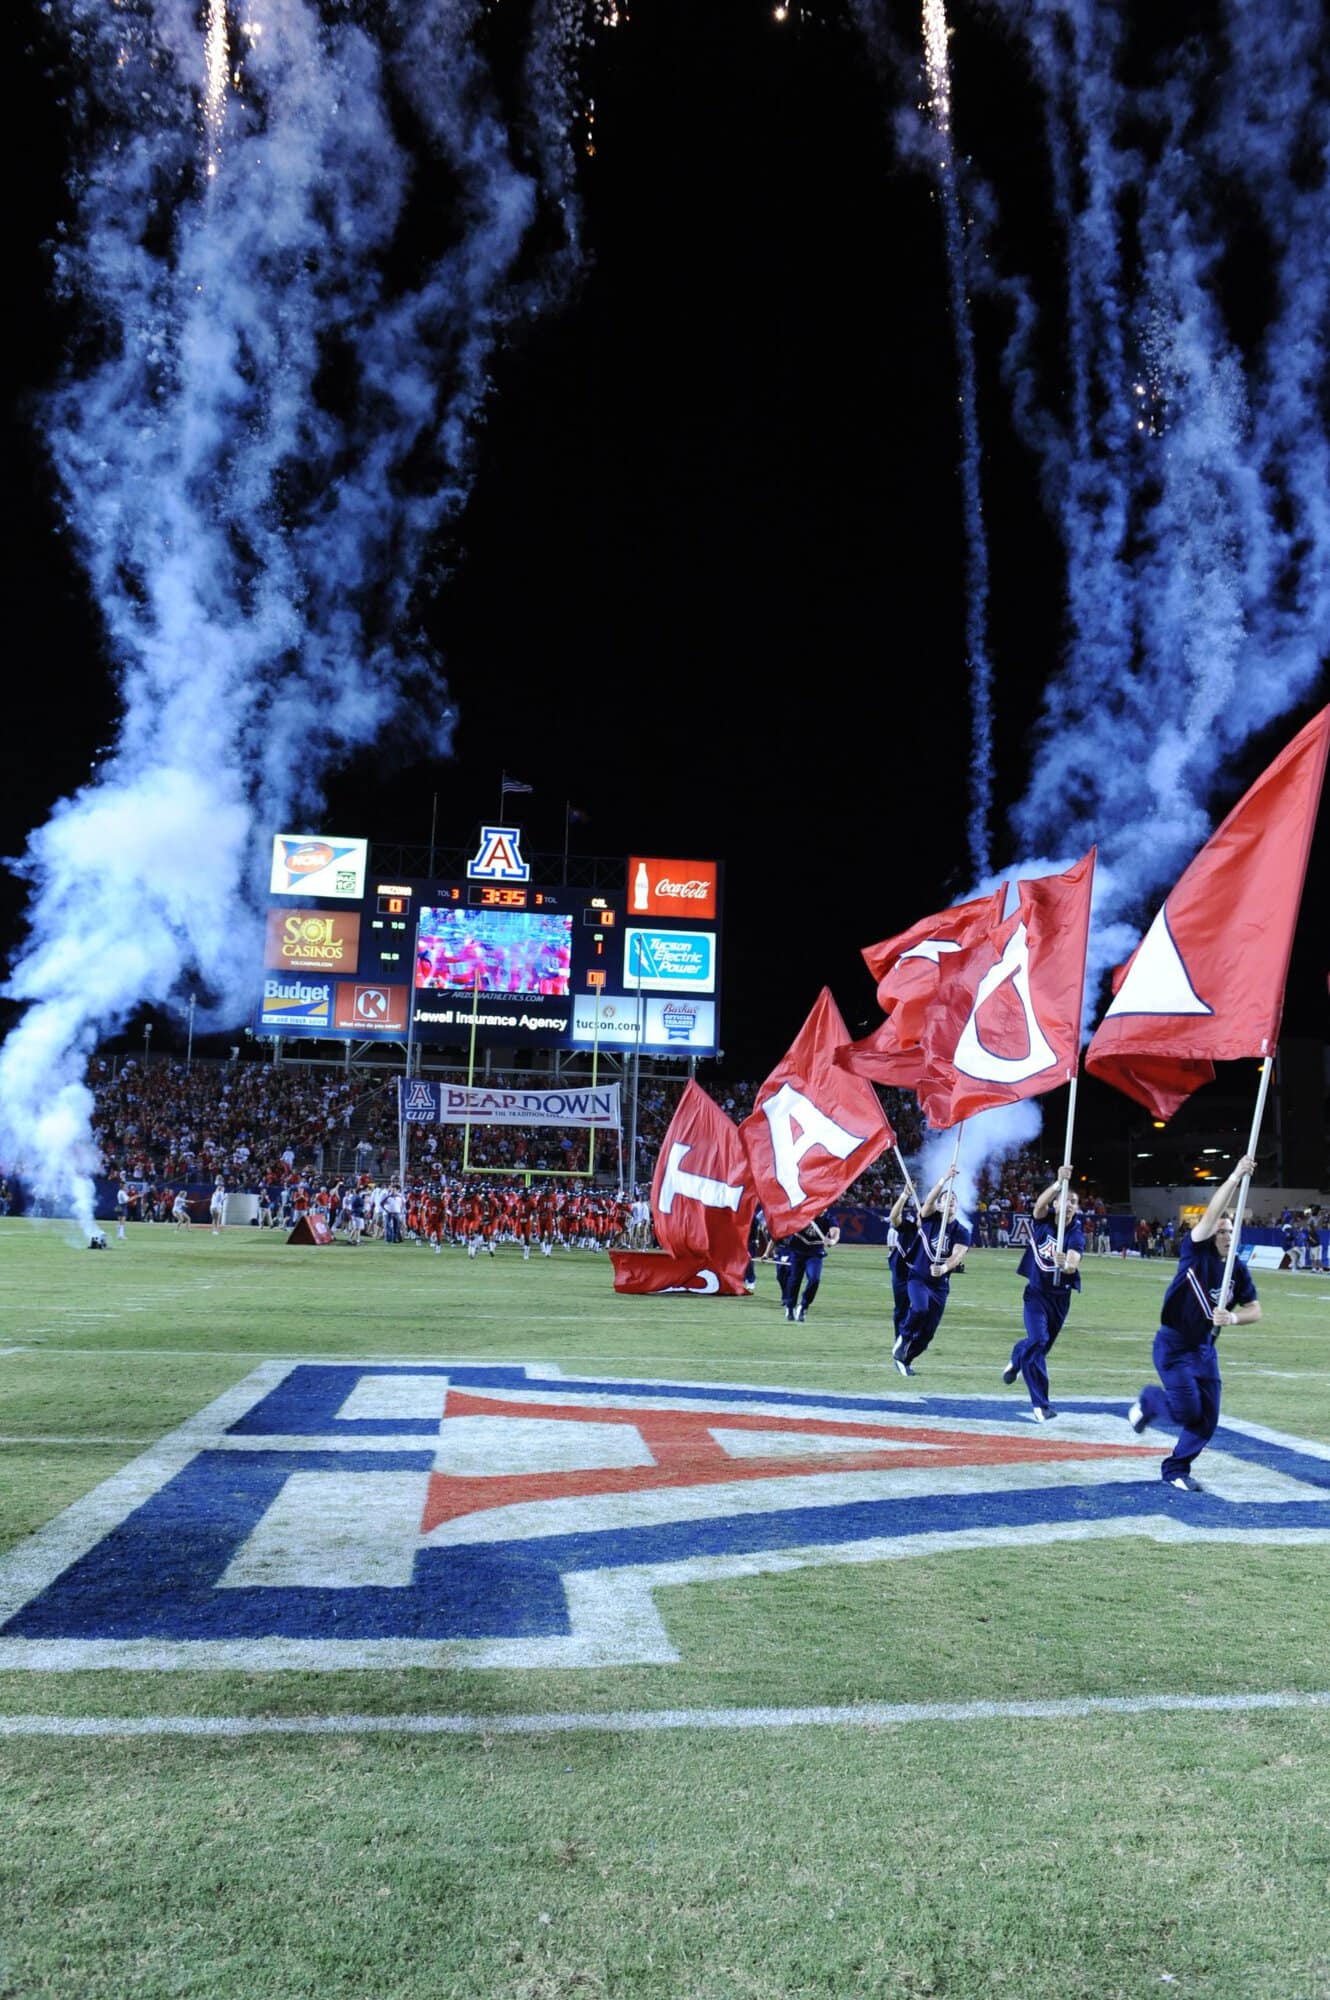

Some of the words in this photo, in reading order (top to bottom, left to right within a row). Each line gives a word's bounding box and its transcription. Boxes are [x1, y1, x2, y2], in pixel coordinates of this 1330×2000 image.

[467, 826, 530, 882] A
[451, 889, 460, 900] 3
[481, 888, 526, 905] 3:35
[655, 878, 712, 899] Coca-Cola
[388, 898, 402, 913] 0
[535, 894, 544, 904] 3
[601, 911, 614, 926] 0
[282, 916, 344, 947] SOL
[281, 944, 344, 960] CASINOS
[650, 938, 693, 952] Tucson
[654, 950, 703, 963] Electric
[658, 961, 703, 974] Power
[264, 980, 330, 1004] Budget
[413, 1009, 454, 1024] Jewell
[519, 1014, 568, 1031] Agency
[405, 1081, 436, 1110] A
[523, 1092, 611, 1115] DOWN
[406, 1111, 435, 1121] CLUB
[761, 1081, 868, 1209] A
[658, 1141, 745, 1215] T
